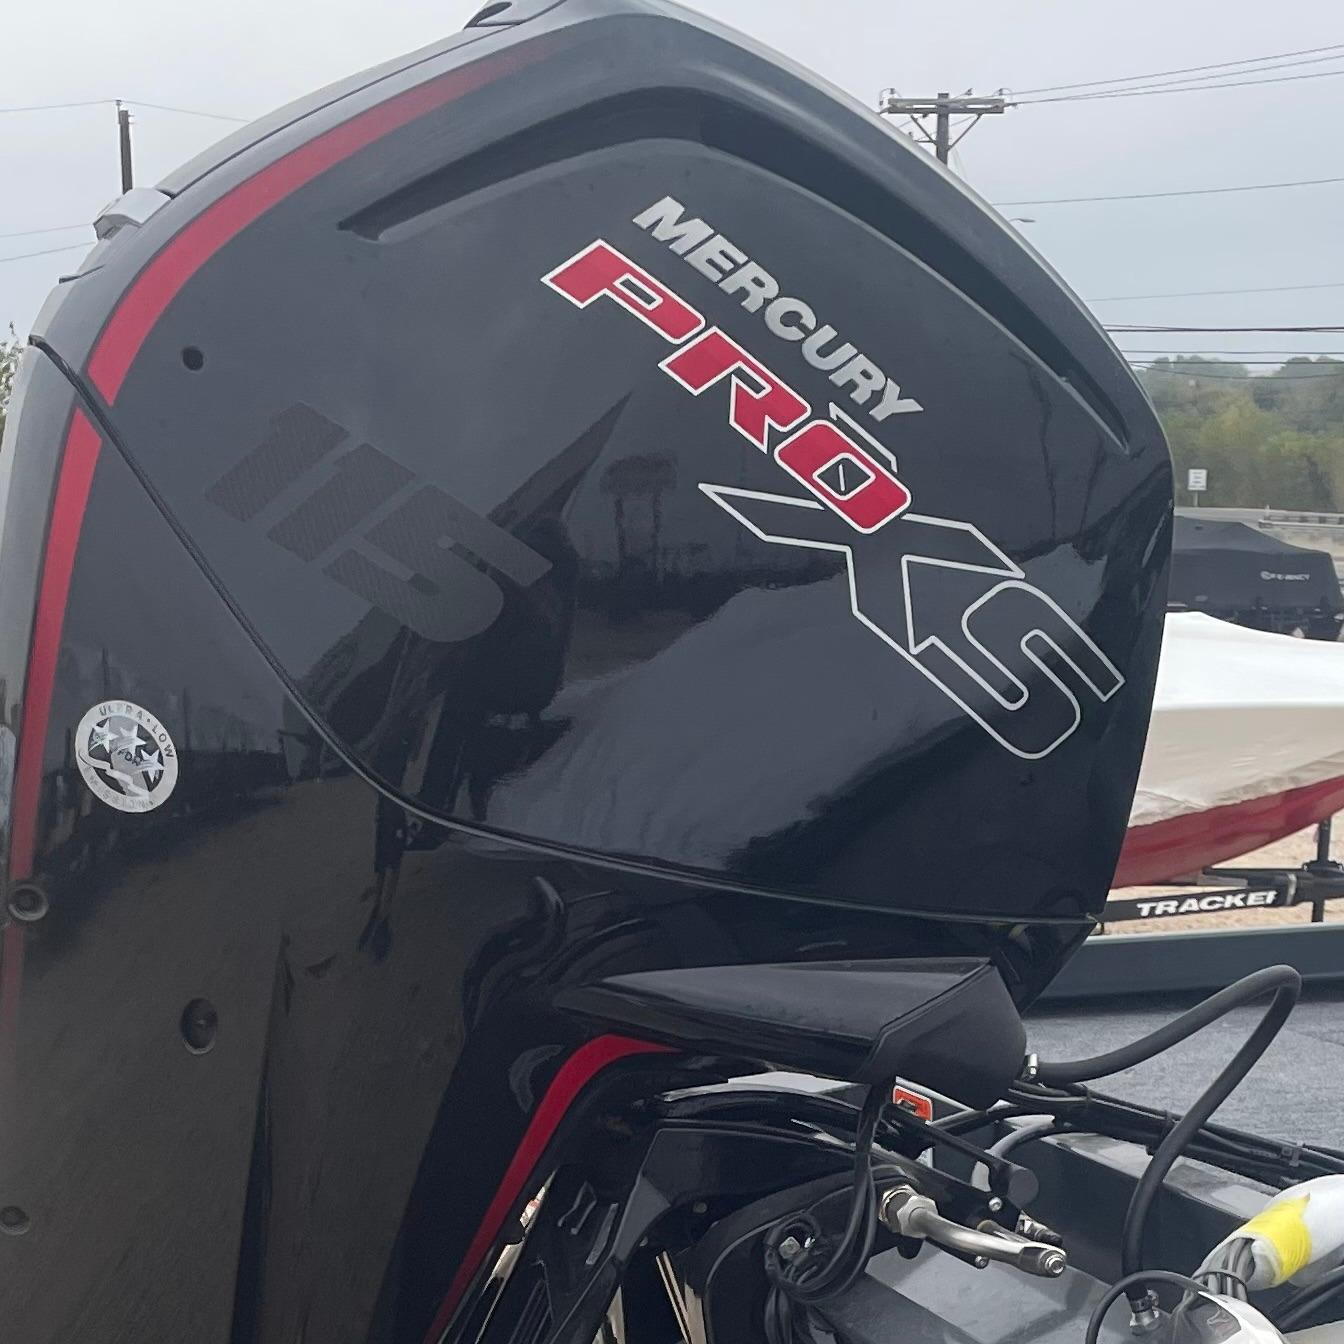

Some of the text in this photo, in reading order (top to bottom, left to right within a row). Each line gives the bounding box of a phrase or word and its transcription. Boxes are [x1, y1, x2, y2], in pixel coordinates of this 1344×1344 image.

[540, 238, 912, 534] PRO
[632, 196, 924, 422] MERCURY
[203, 400, 554, 644] 115
[698, 402, 1126, 760] XS
